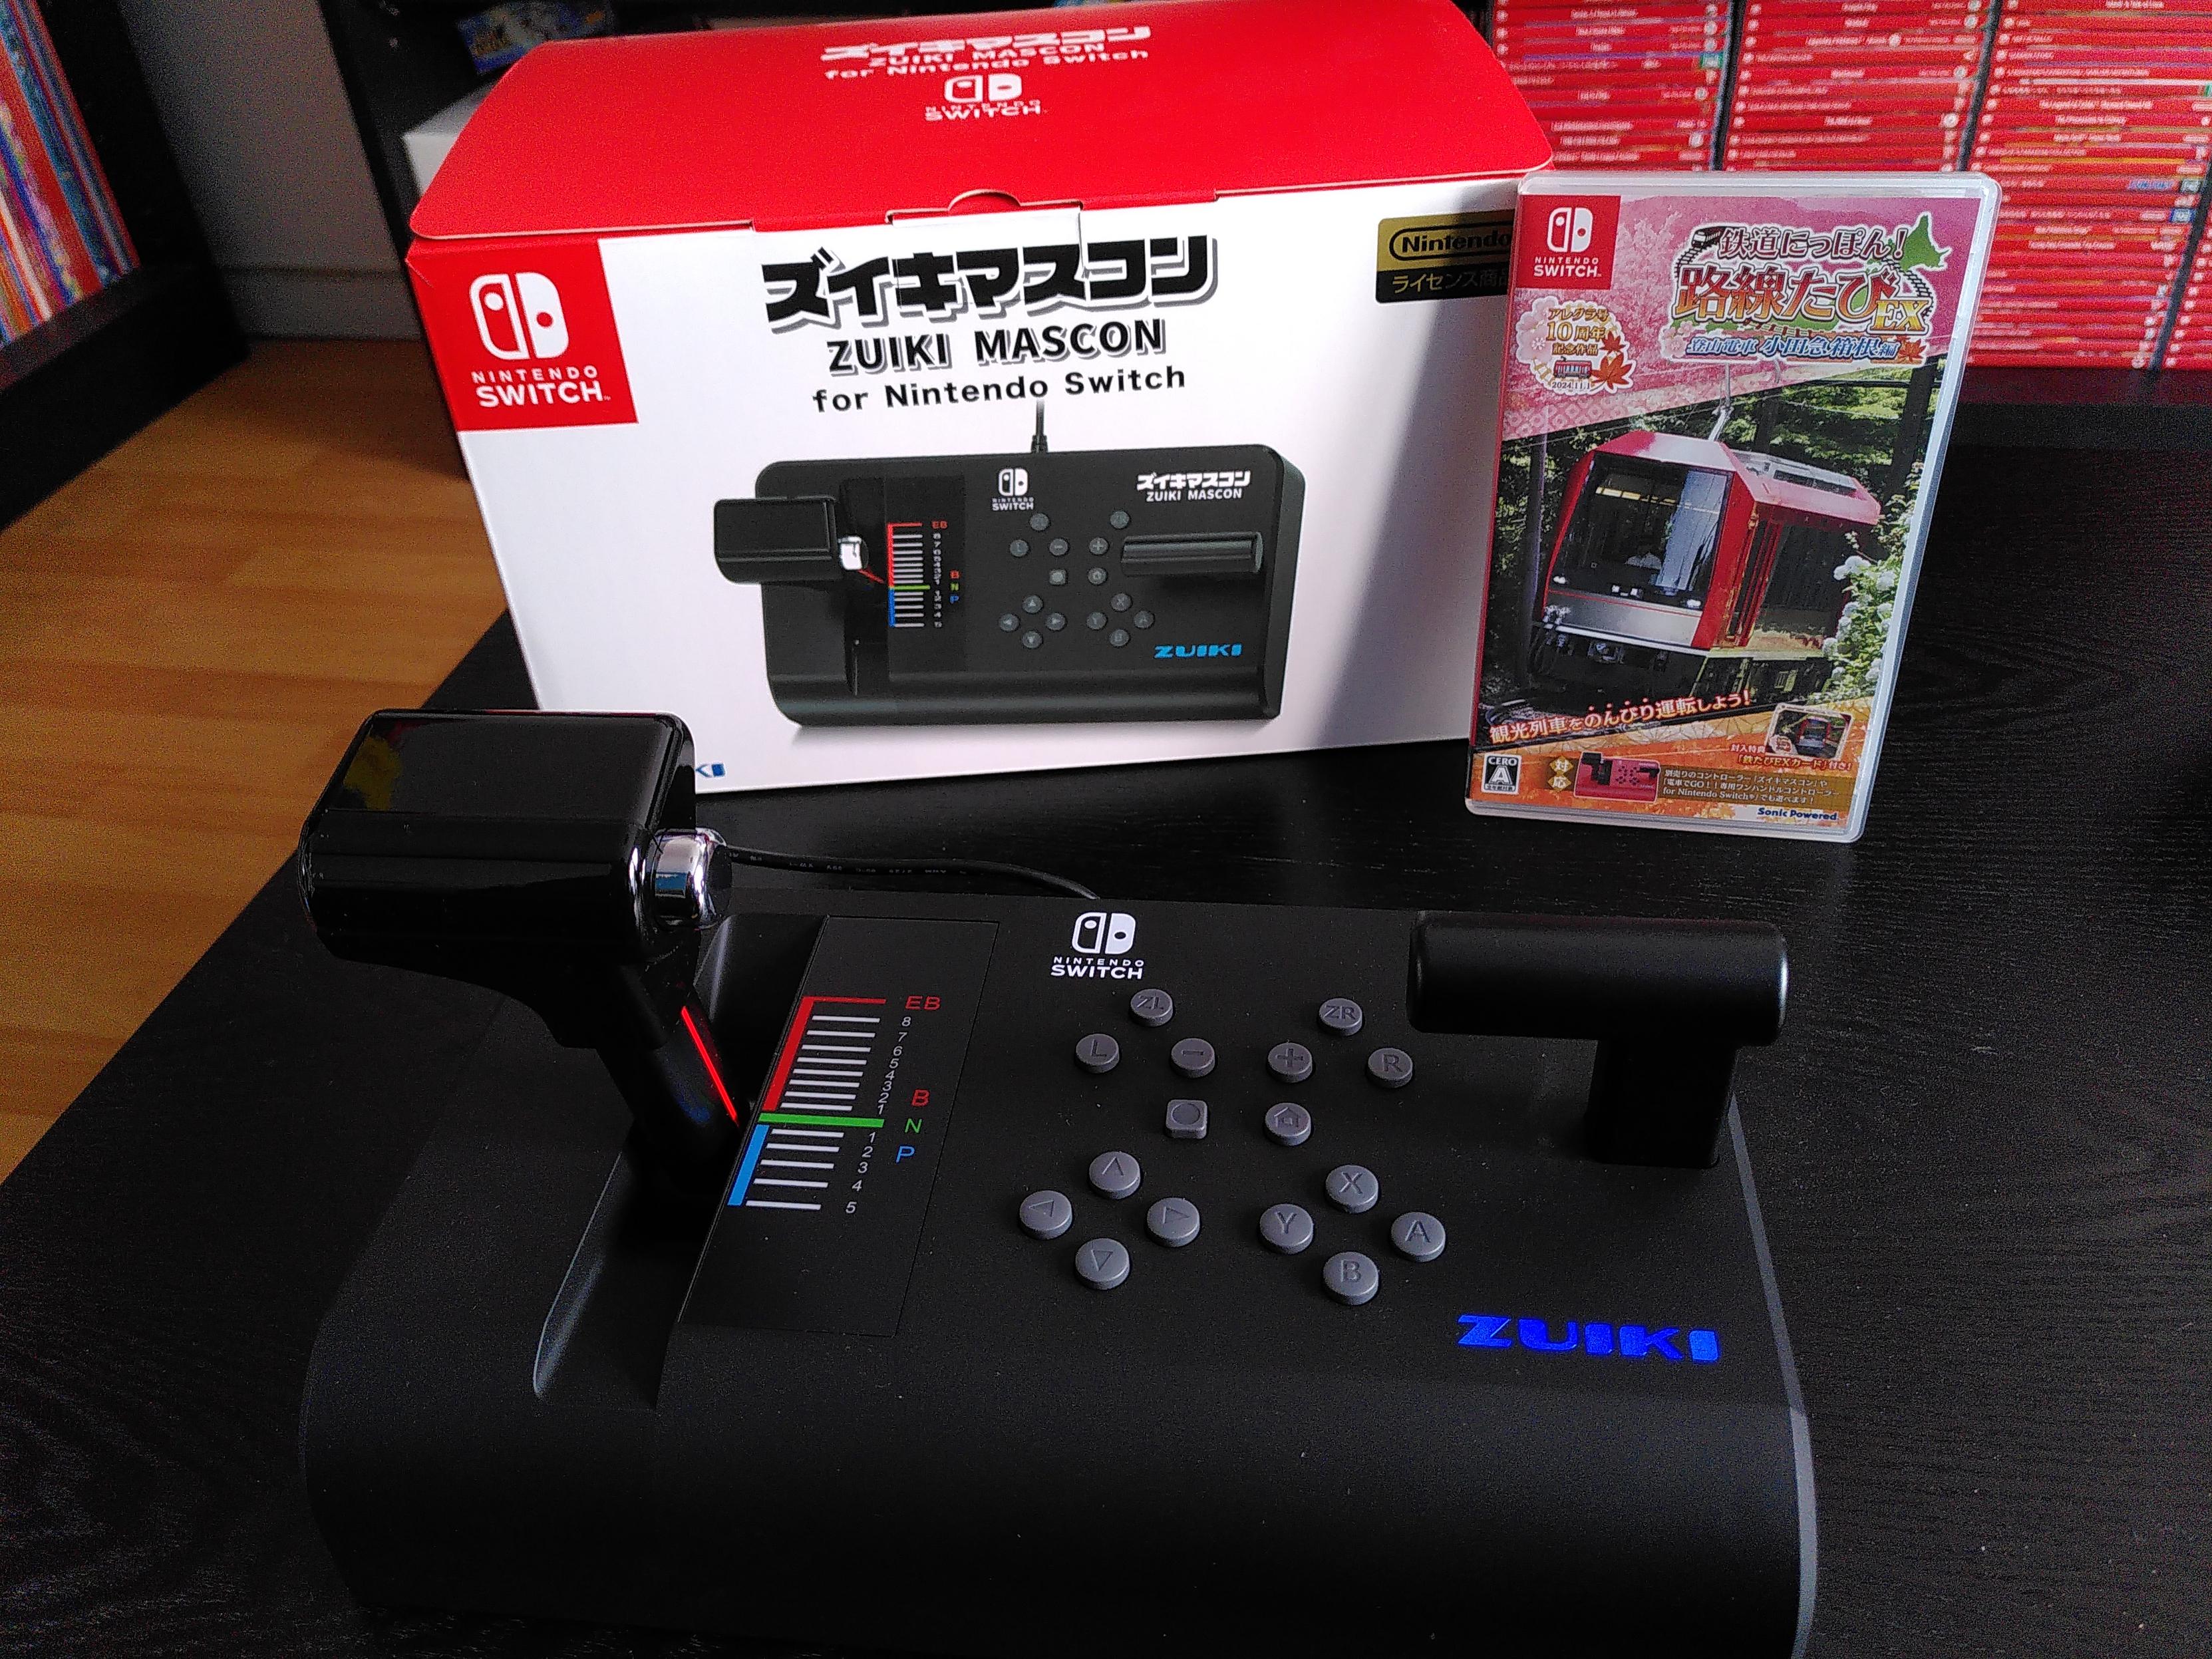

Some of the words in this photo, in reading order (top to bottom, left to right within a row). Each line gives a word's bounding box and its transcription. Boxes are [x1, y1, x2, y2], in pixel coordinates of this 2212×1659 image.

[972, 43, 1105, 61] MASCON
[824, 69, 873, 79] for
[887, 58, 1030, 76] Nintendo
[1043, 49, 1148, 65] Switch
[925, 104, 1042, 121] SWITCH
[1400, 230, 1511, 253] Nintendo
[1533, 265, 1599, 277] SWITCH
[762, 235, 1217, 333] ズイキマスコン
[1548, 308, 1609, 322] アレグラ号
[1869, 297, 1931, 333] EX
[1546, 321, 1606, 342] 10周年
[826, 333, 952, 376] ZUIKI
[974, 317, 1166, 367] MASCON
[1552, 343, 1599, 355] 記念作品
[471, 365, 598, 384] NINTENDO
[812, 388, 869, 412] for
[885, 373, 1049, 408] Nintendo
[1064, 365, 1186, 395] Switch
[1137, 470, 1251, 491] ズイキマスコン
[1146, 491, 1182, 502] ZUIKI
[1187, 488, 1242, 501] MASCON
[992, 502, 1034, 511] SWITCH
[1154, 643, 1242, 659] ZUIKI
[1488, 757, 1517, 766] CERO
[1489, 766, 1512, 785] A
[1678, 788, 1718, 798] Nintendo
[1758, 807, 1789, 817] Sonic
[1790, 810, 1838, 820] Powered
[1053, 956, 1144, 967] NINTENDO
[1050, 965, 1144, 979] SWITCH
[905, 996, 941, 1010] EB
[1323, 1004, 1356, 1020] ZR
[901, 1016, 911, 1027] 8
[898, 1032, 908, 1042] 7
[893, 1046, 903, 1056] 6
[1091, 1039, 1108, 1057] L
[889, 1058, 899, 1068] 5
[1382, 1054, 1403, 1073] R
[885, 1070, 895, 1080] 4
[882, 1080, 893, 1091] 3
[878, 1093, 889, 1104] 2
[911, 1089, 930, 1107] B
[877, 1104, 885, 1115] 1
[904, 1118, 923, 1133] N
[868, 1132, 877, 1143] 1
[862, 1146, 873, 1157] 2
[895, 1145, 915, 1163] P
[857, 1162, 868, 1173] 3
[852, 1180, 862, 1191] 4
[1339, 1171, 1364, 1194] X
[845, 1202, 858, 1214] 5
[1275, 1211, 1298, 1235] Y
[1404, 1219, 1431, 1243] A
[1341, 1259, 1362, 1282] B
[1457, 1314, 1720, 1362] ZUIKI
